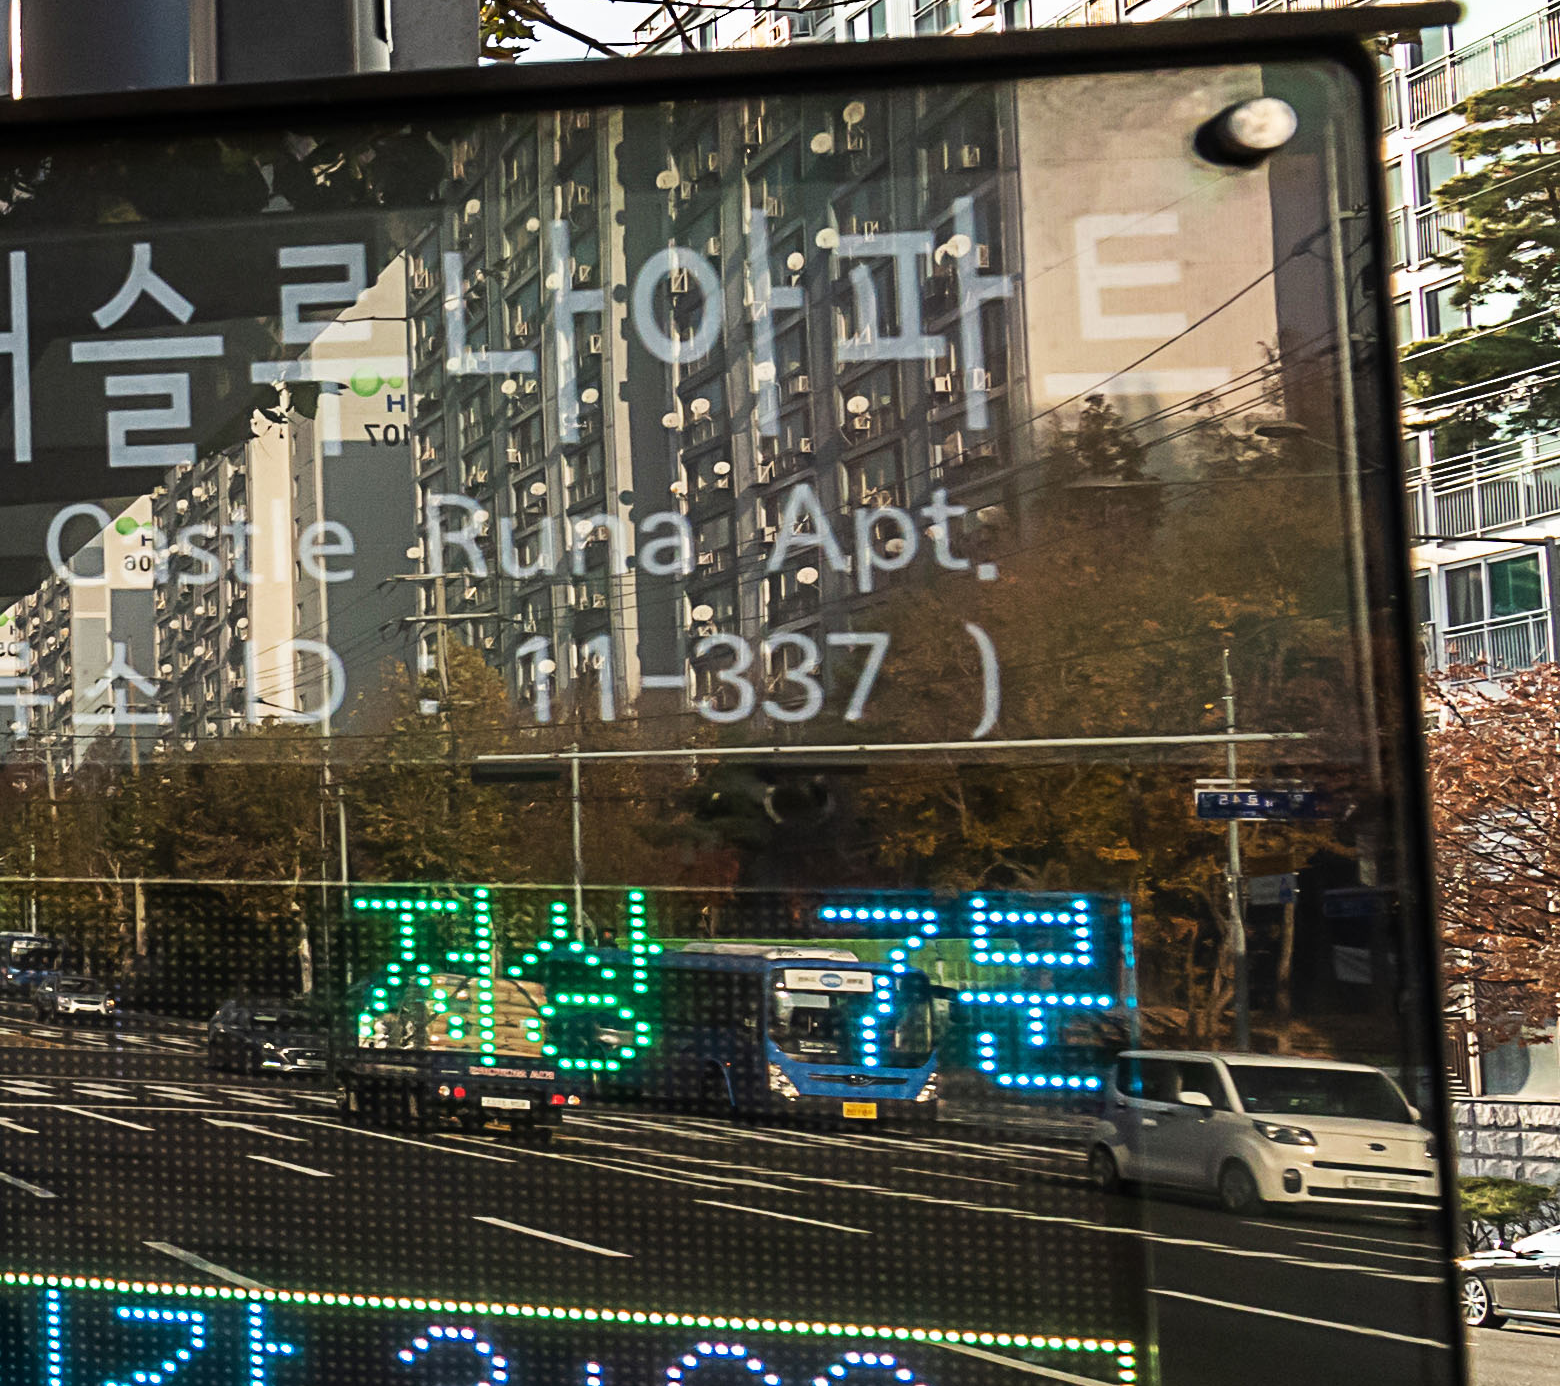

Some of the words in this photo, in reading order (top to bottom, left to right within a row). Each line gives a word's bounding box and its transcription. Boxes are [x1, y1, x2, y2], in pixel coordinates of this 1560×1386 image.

[47, 497, 357, 591] Castle
[423, 493, 694, 583] Runa
[768, 484, 1002, 586] Apt.
[243, 635, 343, 731] ID
[515, 623, 895, 730] 11-337
